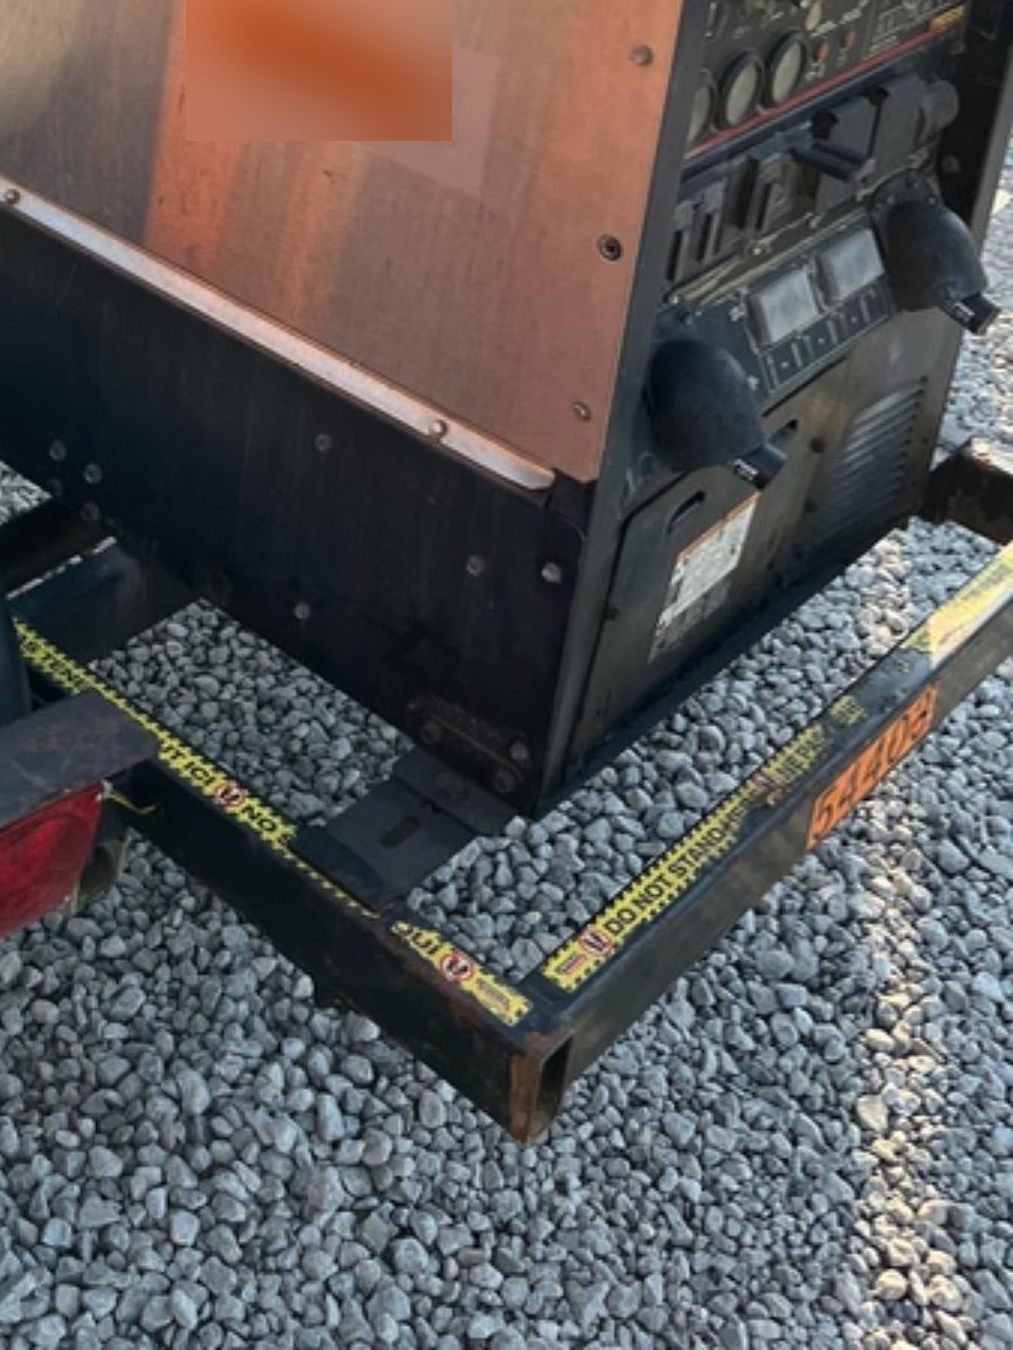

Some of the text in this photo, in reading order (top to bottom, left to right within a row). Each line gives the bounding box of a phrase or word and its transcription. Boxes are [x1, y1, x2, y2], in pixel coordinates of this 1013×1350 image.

[603, 907, 638, 935] DO
[630, 875, 673, 910] NOT
[667, 825, 726, 878] STAND
